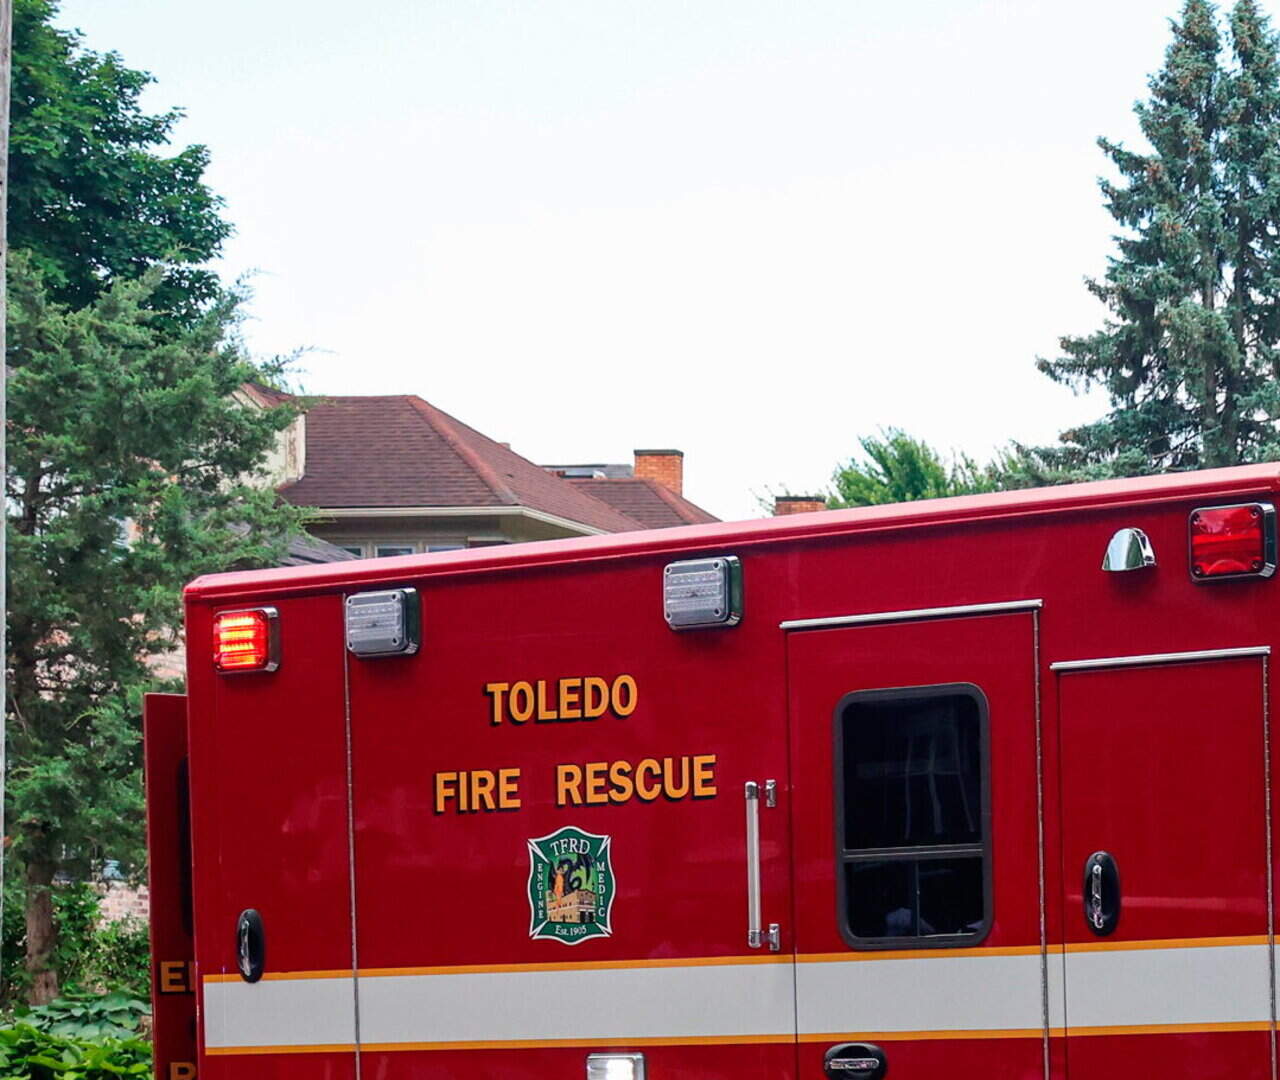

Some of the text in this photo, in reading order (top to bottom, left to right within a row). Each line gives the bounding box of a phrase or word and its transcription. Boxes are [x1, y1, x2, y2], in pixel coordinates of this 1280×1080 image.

[485, 674, 638, 724] TOLEDO
[434, 754, 717, 814] FIRE RESCUE
[549, 838, 592, 857] TFRD
[536, 863, 545, 920] ENGINE
[596, 862, 606, 918] MEDIC
